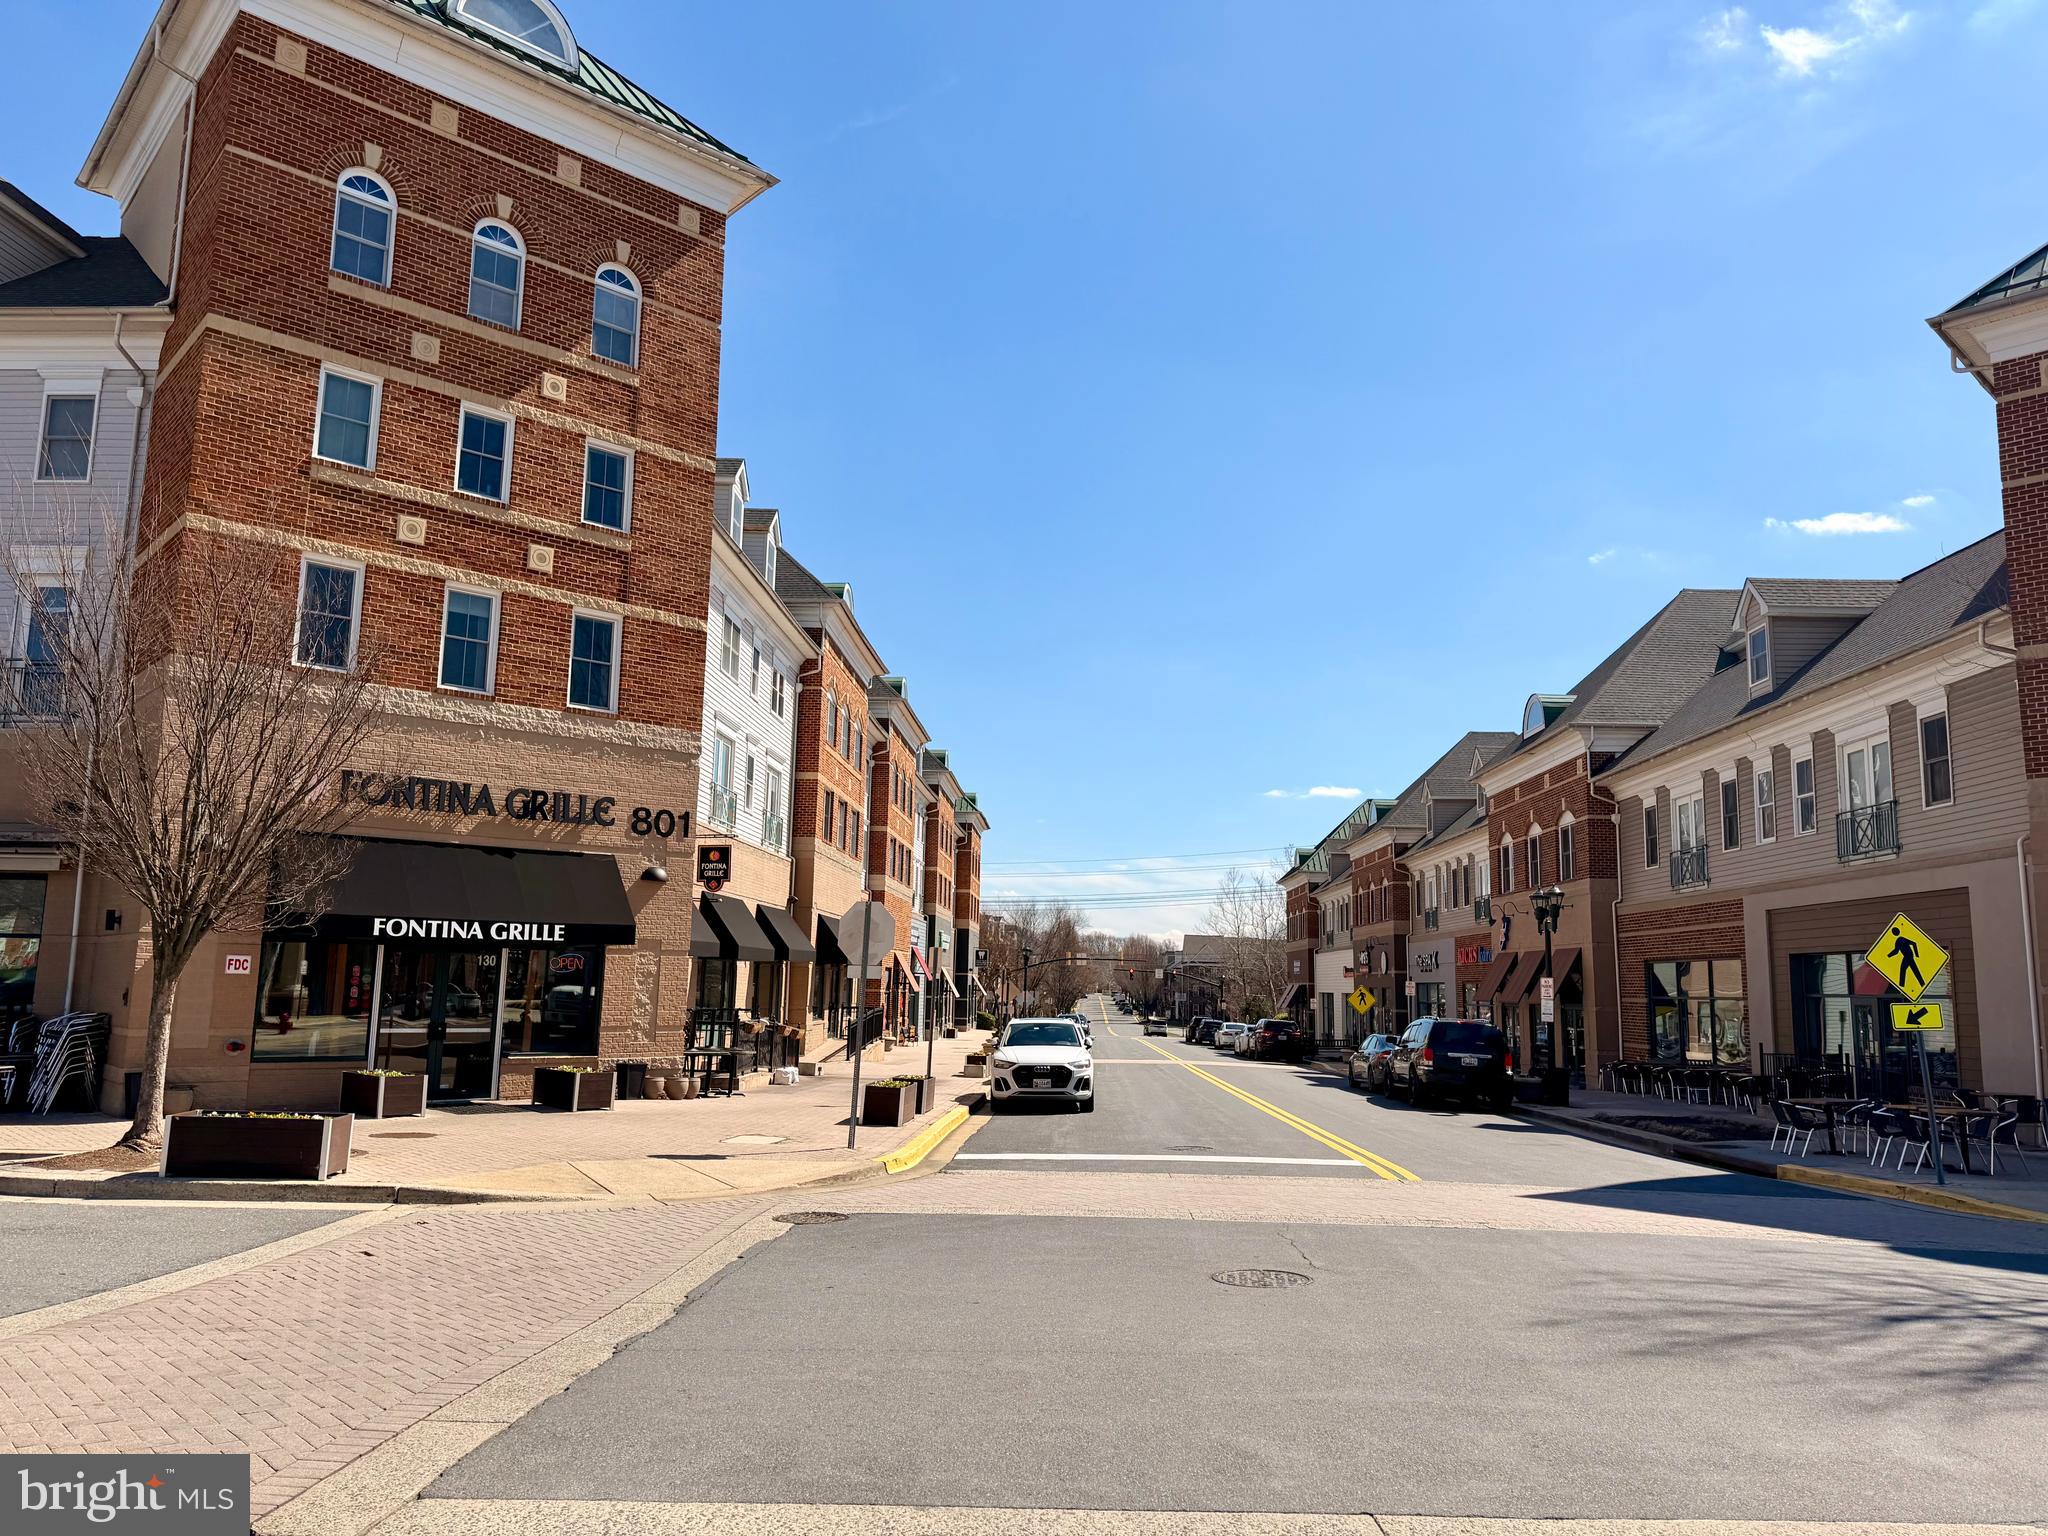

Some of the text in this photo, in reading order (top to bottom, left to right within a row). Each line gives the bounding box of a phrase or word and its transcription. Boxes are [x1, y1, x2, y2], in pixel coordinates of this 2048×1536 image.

[340, 769, 616, 827] FONTINA GRILLE
[631, 806, 691, 839] 801
[373, 917, 566, 942] FONTINA GRILLE
[227, 958, 249, 971] FDC
[477, 954, 497, 967] 130
[549, 955, 584, 970] OPEN
